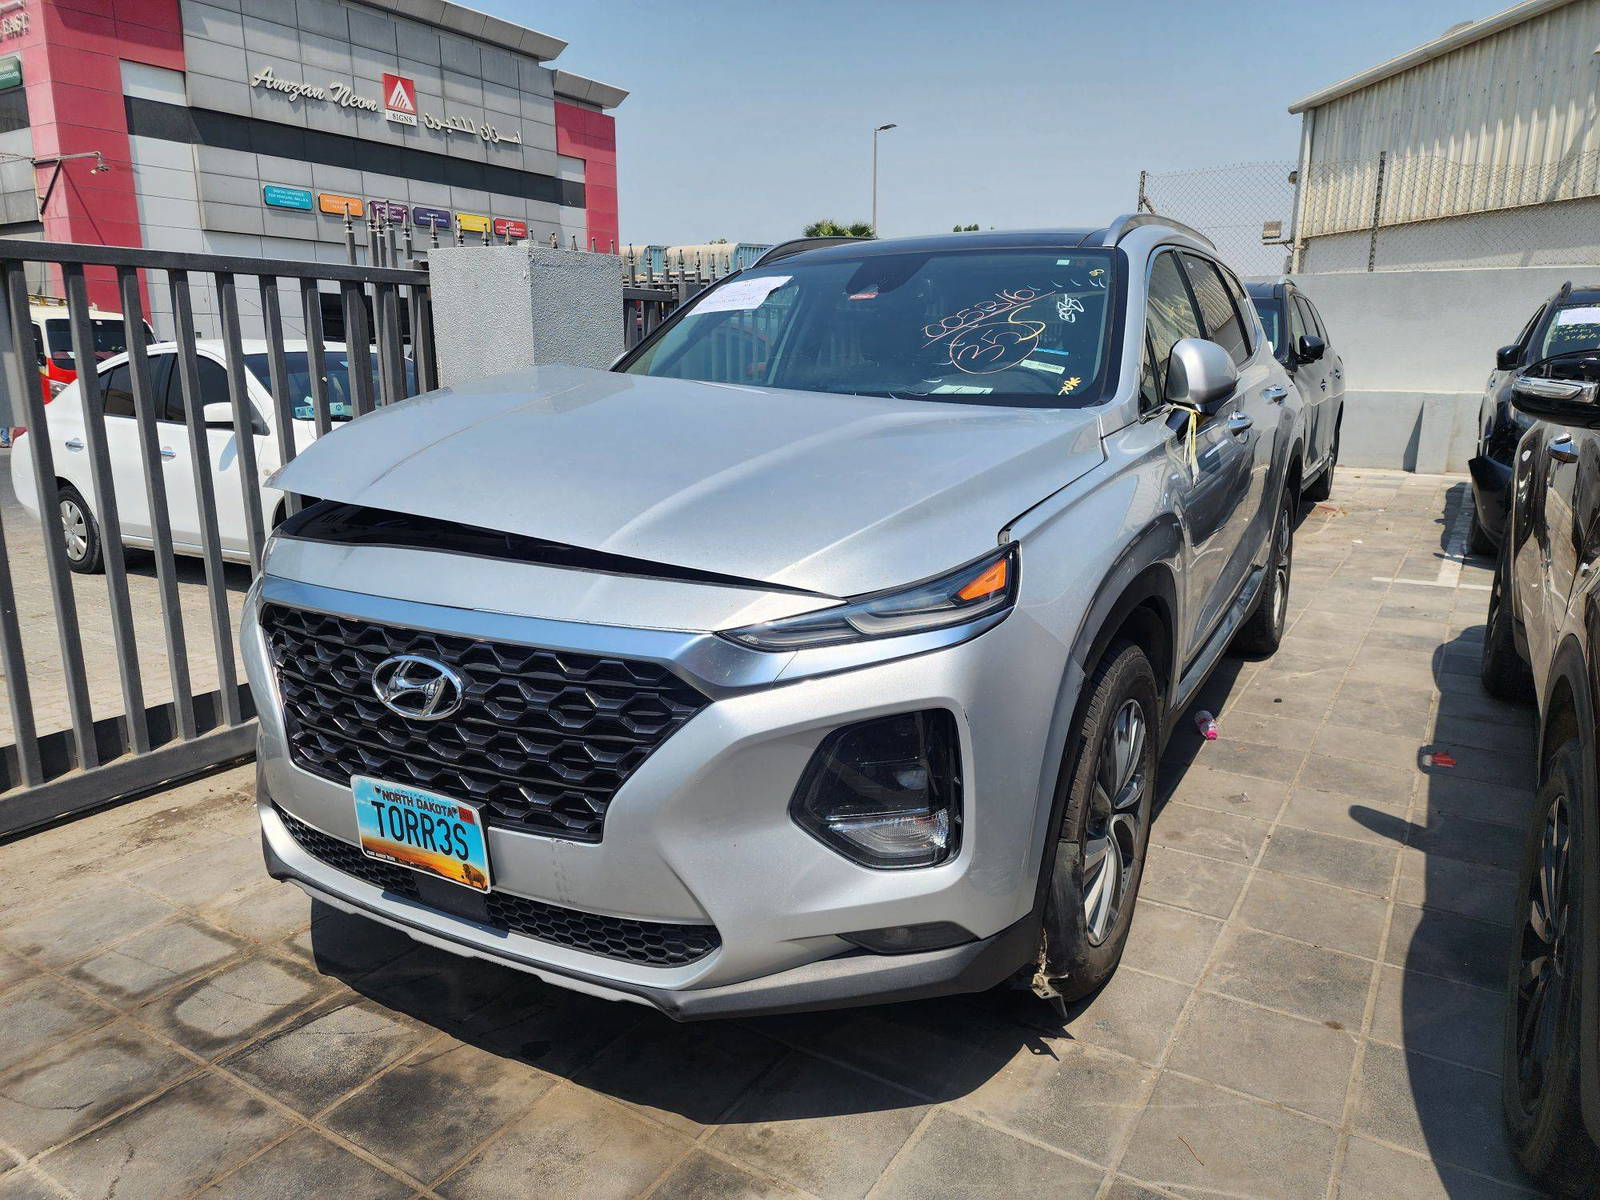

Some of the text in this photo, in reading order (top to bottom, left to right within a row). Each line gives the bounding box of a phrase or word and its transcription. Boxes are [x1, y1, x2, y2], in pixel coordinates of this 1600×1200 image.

[252, 66, 378, 112] Amzan Neon
[392, 113, 413, 124] SIGNS
[382, 790, 414, 808] NORTH
[416, 799, 454, 818] DAKOTA
[371, 801, 469, 861] TORR3S
